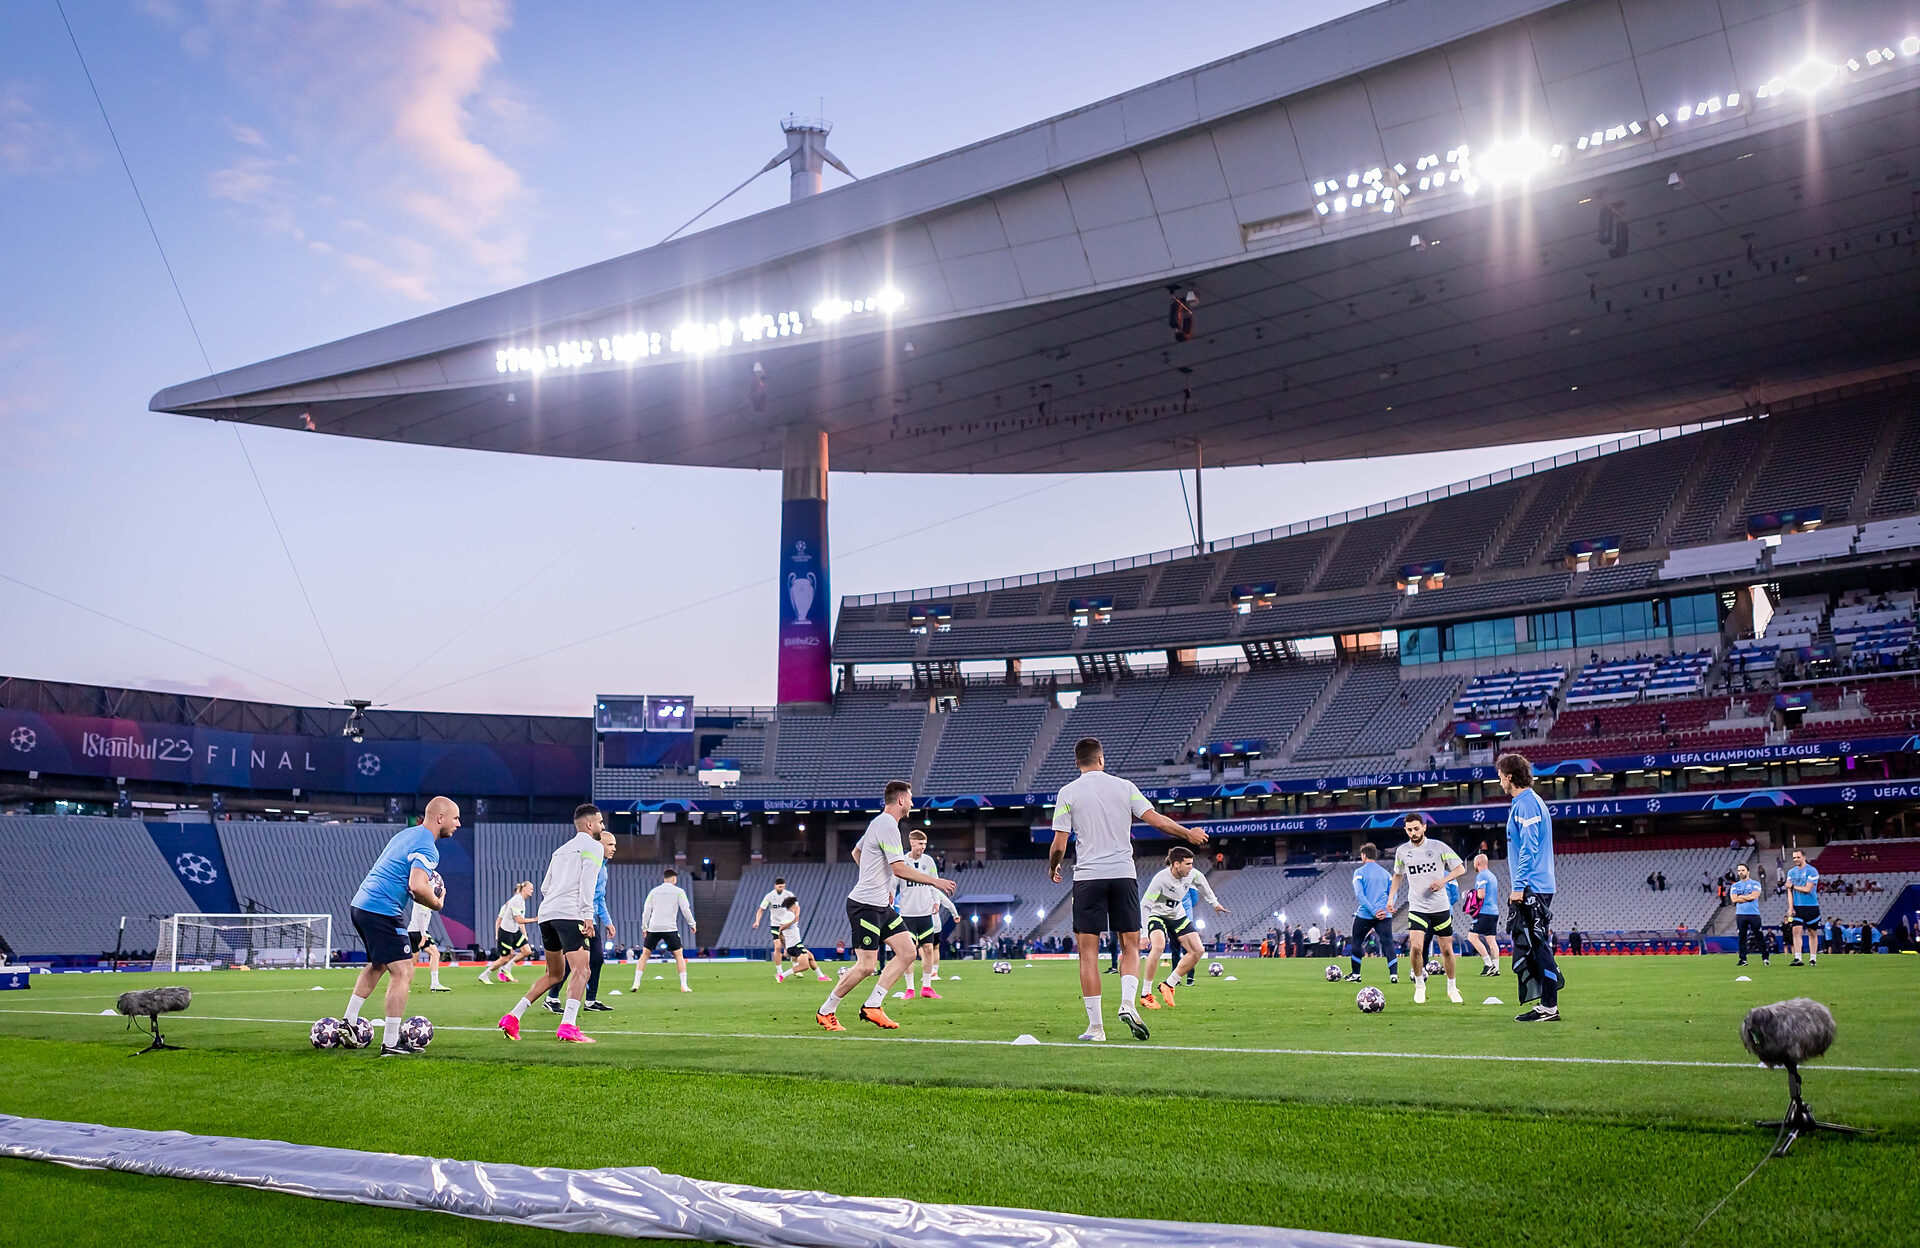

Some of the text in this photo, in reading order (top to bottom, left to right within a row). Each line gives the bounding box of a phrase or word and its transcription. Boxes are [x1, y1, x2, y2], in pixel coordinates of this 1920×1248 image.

[207, 745, 317, 771] FINAL
[1671, 744, 1821, 764] UEFA CHAMPIONS LEAGUE
[1398, 770, 1449, 783] FINAL
[1873, 786, 1907, 797] UEFA
[813, 799, 860, 809] FINAL
[1565, 802, 1622, 816] FINAL
[1216, 822, 1268, 833] CHAMPIONS
[1270, 820, 1305, 831] LEAGUE
